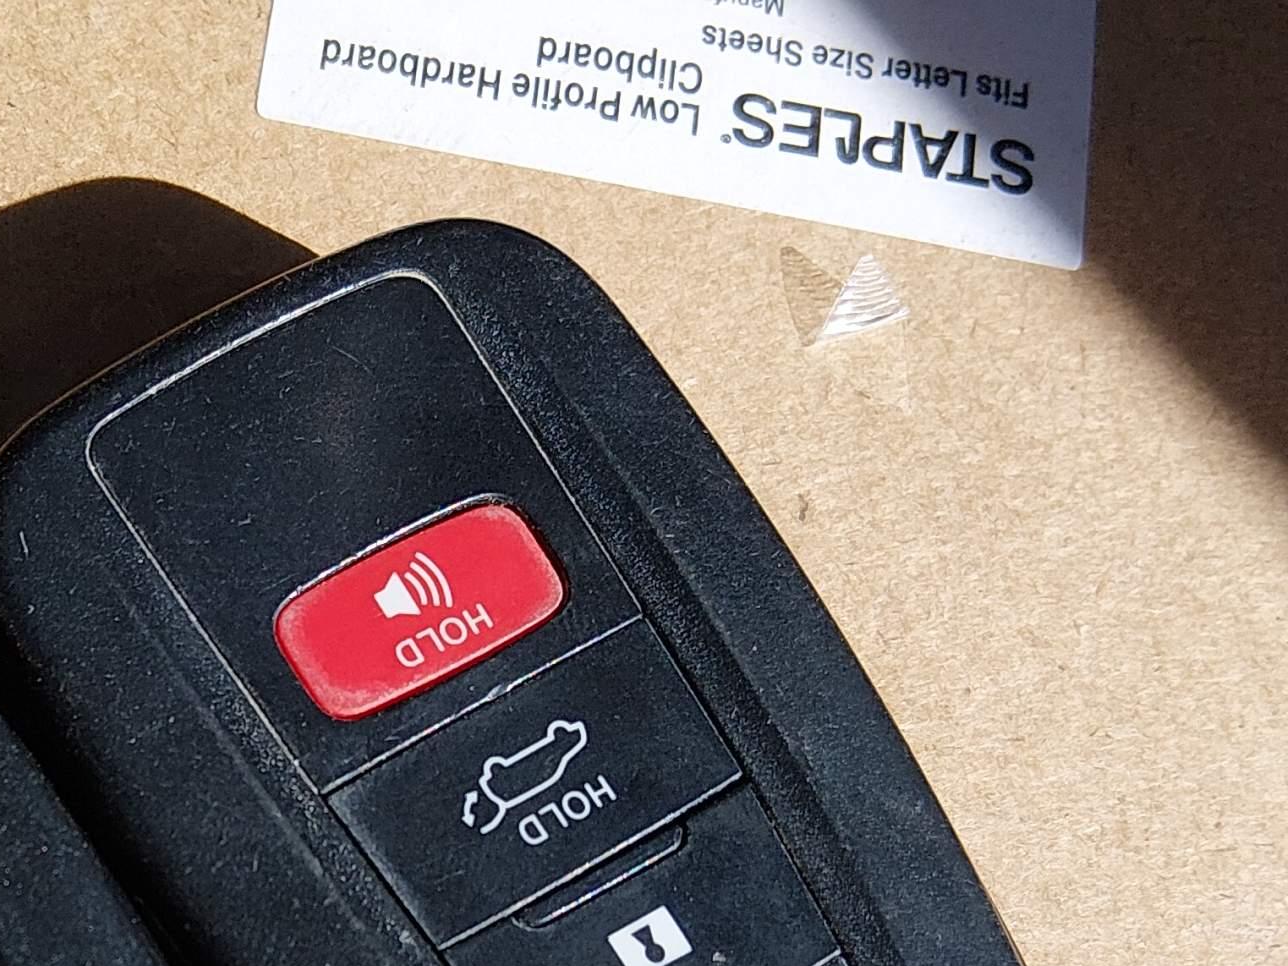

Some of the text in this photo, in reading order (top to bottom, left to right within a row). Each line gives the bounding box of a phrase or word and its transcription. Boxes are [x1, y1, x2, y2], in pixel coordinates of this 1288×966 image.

[319, 38, 701, 137] Low Profile Hardboard
[535, 35, 703, 94] Clipboard
[701, 24, 1030, 110] Fits Letter Size Sheets
[394, 603, 495, 669] HOLD
[517, 774, 618, 846] HOLD
